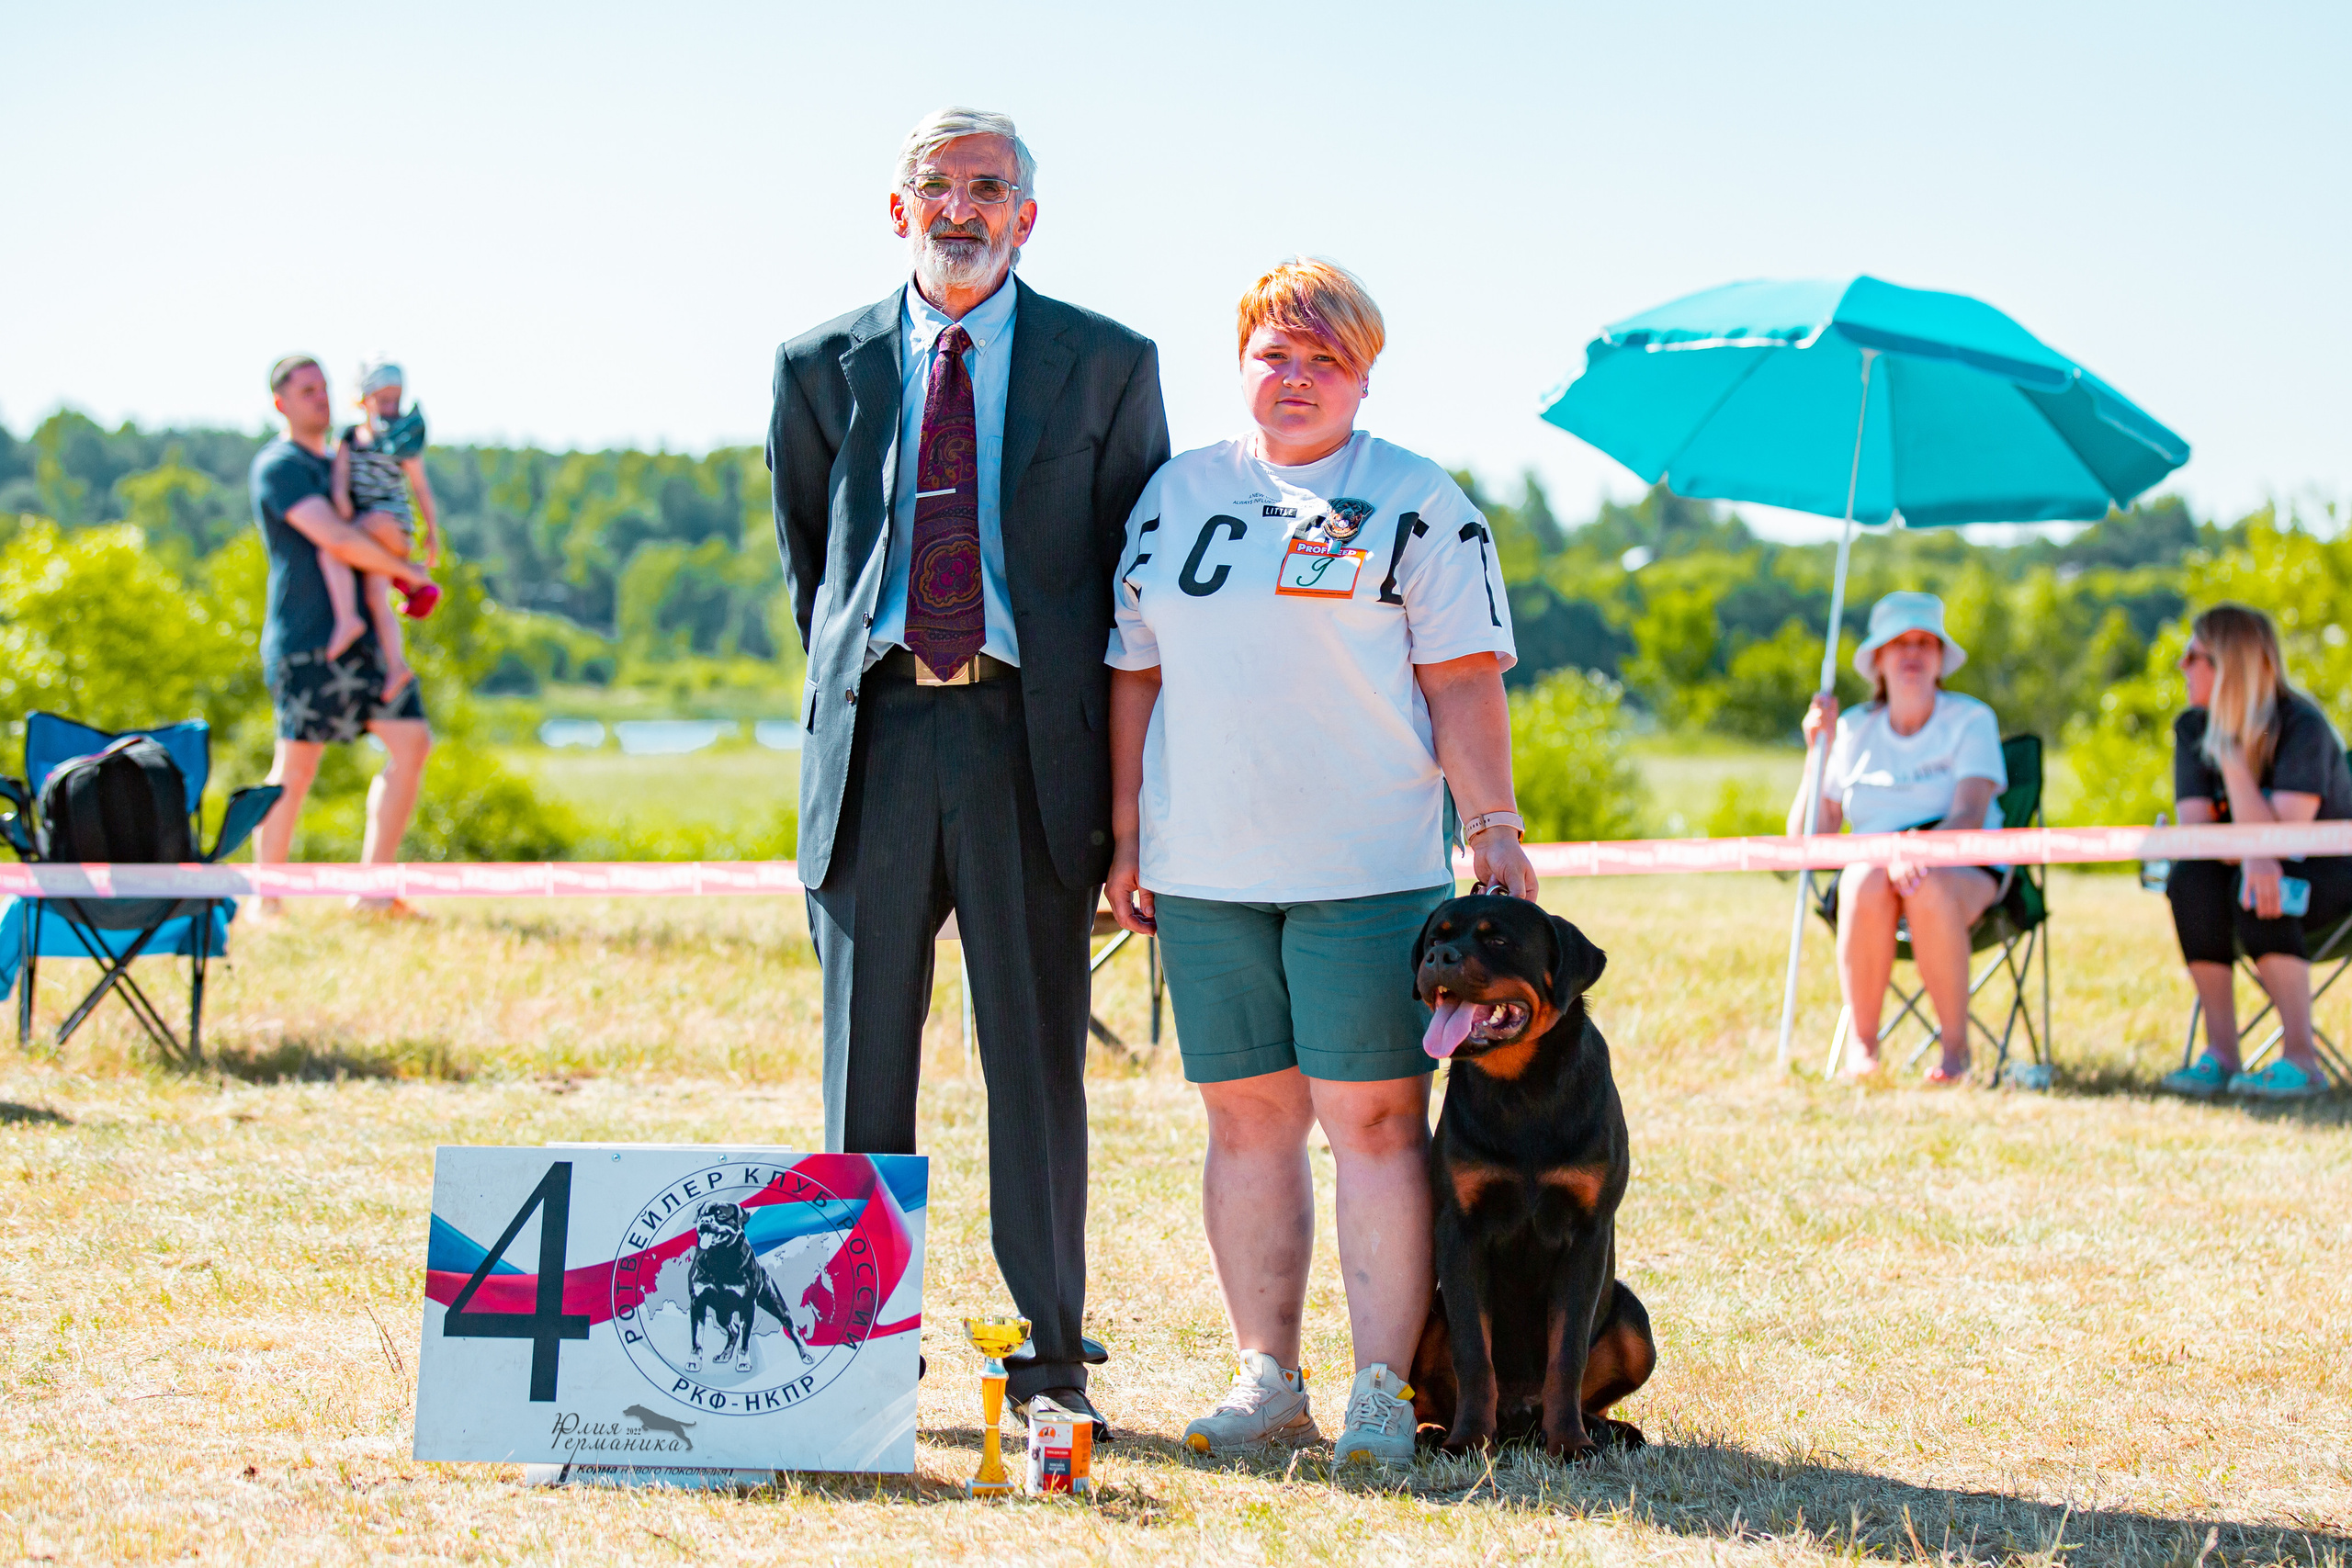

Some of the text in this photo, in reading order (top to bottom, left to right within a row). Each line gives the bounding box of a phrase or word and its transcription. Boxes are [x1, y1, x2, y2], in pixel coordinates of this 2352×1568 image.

[1265, 506, 1295, 516] LITTLE
[443, 1161, 591, 1403] 4
[616, 1167, 874, 1351] РОТВЕЙЛЕР КЛУБ РОССИИ
[672, 1375, 815, 1412] РКФ-НКПР
